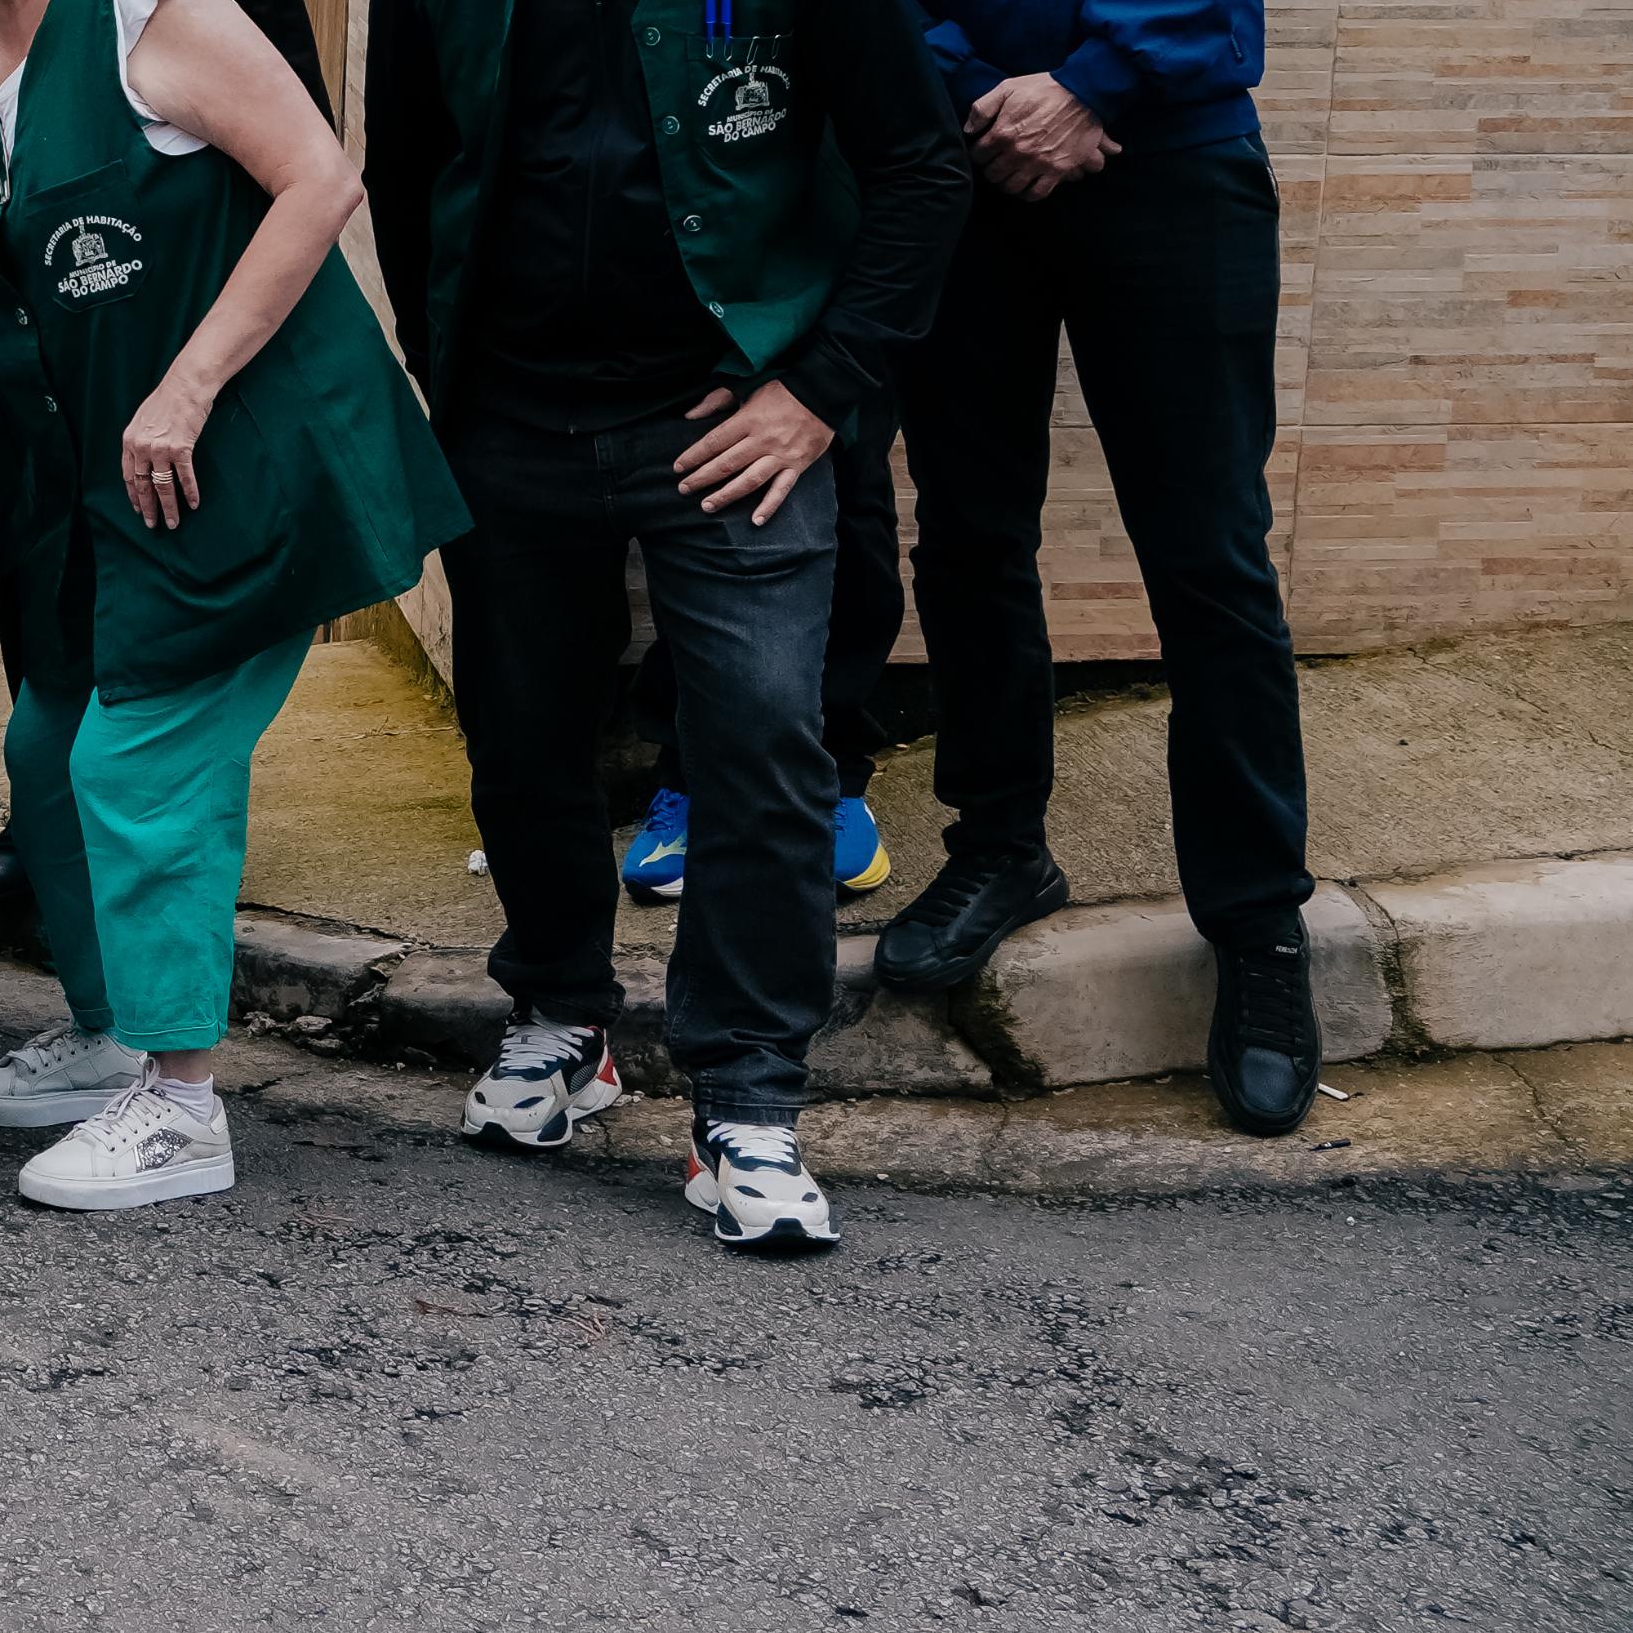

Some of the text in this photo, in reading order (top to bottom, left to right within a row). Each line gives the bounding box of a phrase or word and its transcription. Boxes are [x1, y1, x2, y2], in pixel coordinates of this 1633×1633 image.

[698, 67, 744, 107] SECRETARIA
[744, 65, 758, 74] DE
[708, 108, 787, 135] SÃO BERNARDO
[724, 121, 776, 143] DO CAMPO
[44, 215, 142, 266] SECRETARIA DE HABITAÇÃO
[57, 259, 143, 293] SÃO BERNARDO
[105, 259, 117, 269] DE
[72, 274, 129, 298] DO CAMPO
